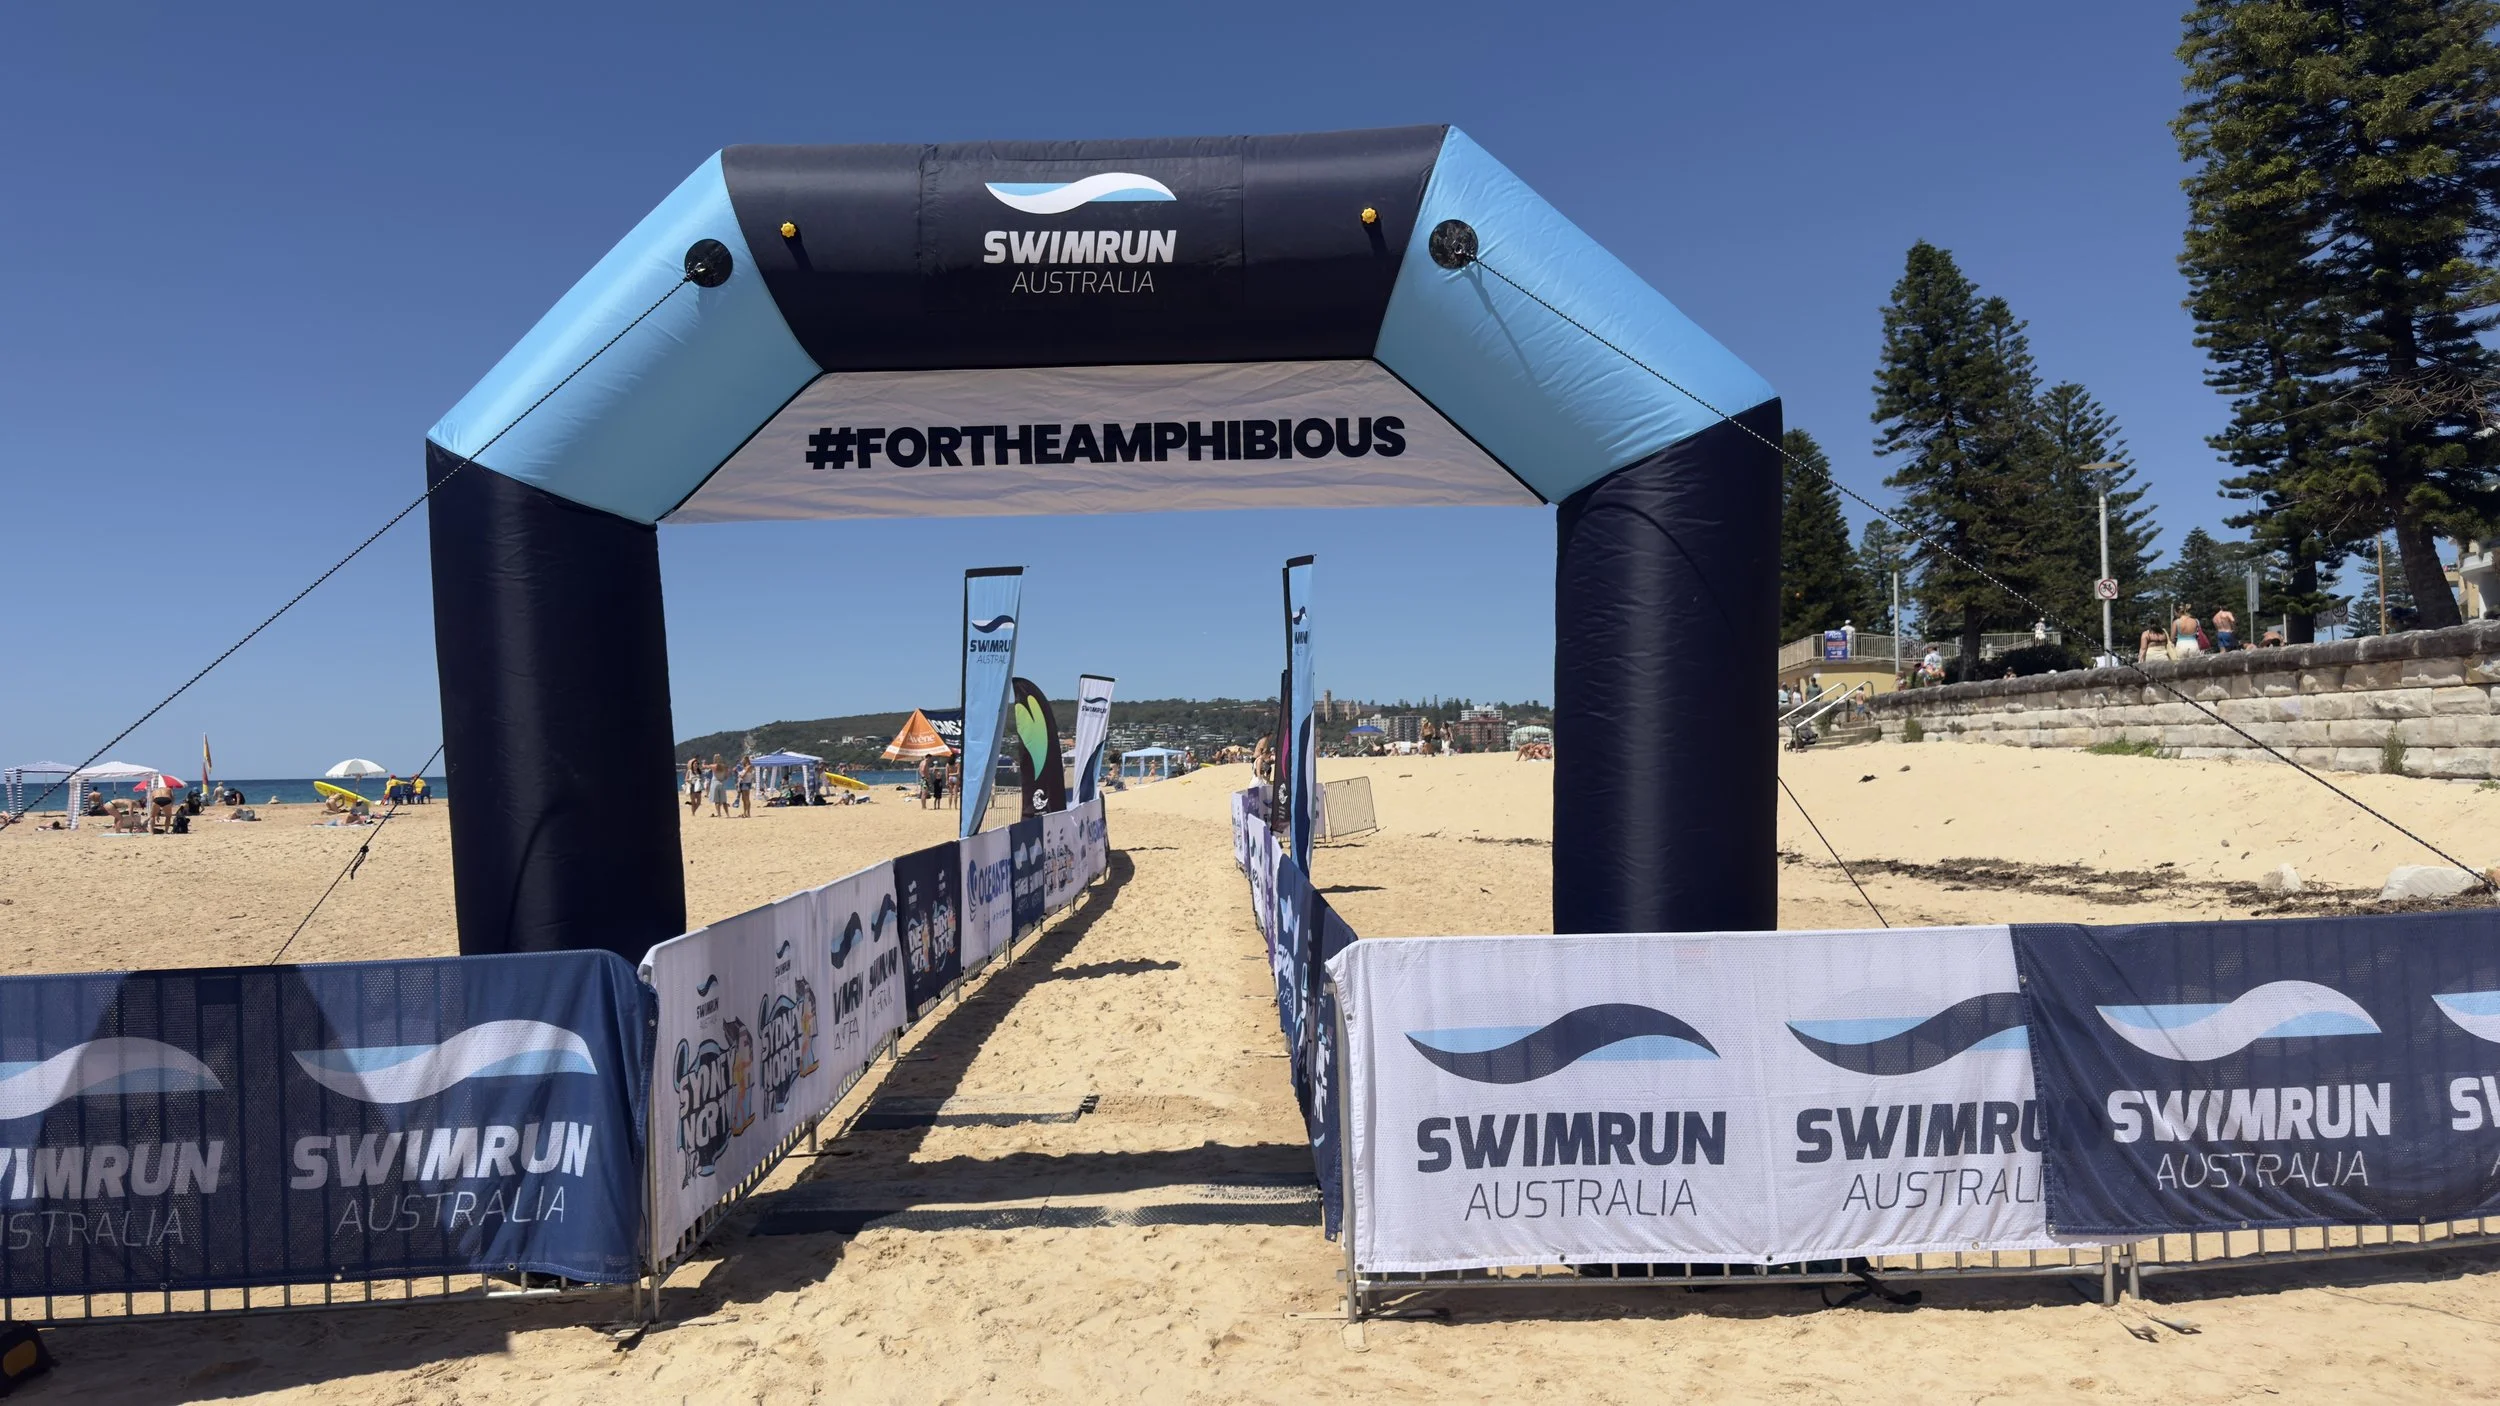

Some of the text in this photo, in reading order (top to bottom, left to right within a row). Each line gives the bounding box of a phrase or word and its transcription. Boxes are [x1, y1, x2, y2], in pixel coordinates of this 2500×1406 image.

[983, 230, 1177, 264] SWIMRUN
[1011, 271, 1155, 294] AUSTRALIA
[805, 416, 1406, 470] #FORTHEAMPHIBIOUS
[2107, 1082, 2391, 1143] SWIMRUN
[290, 1121, 593, 1190] SWIMRUN
[1417, 1111, 1727, 1173] SWIMRUN
[2156, 1150, 2370, 1191] AUSTRALIA
[335, 1186, 565, 1234] AUSTRALIA
[1465, 1178, 1698, 1222] AUSTRALIA
